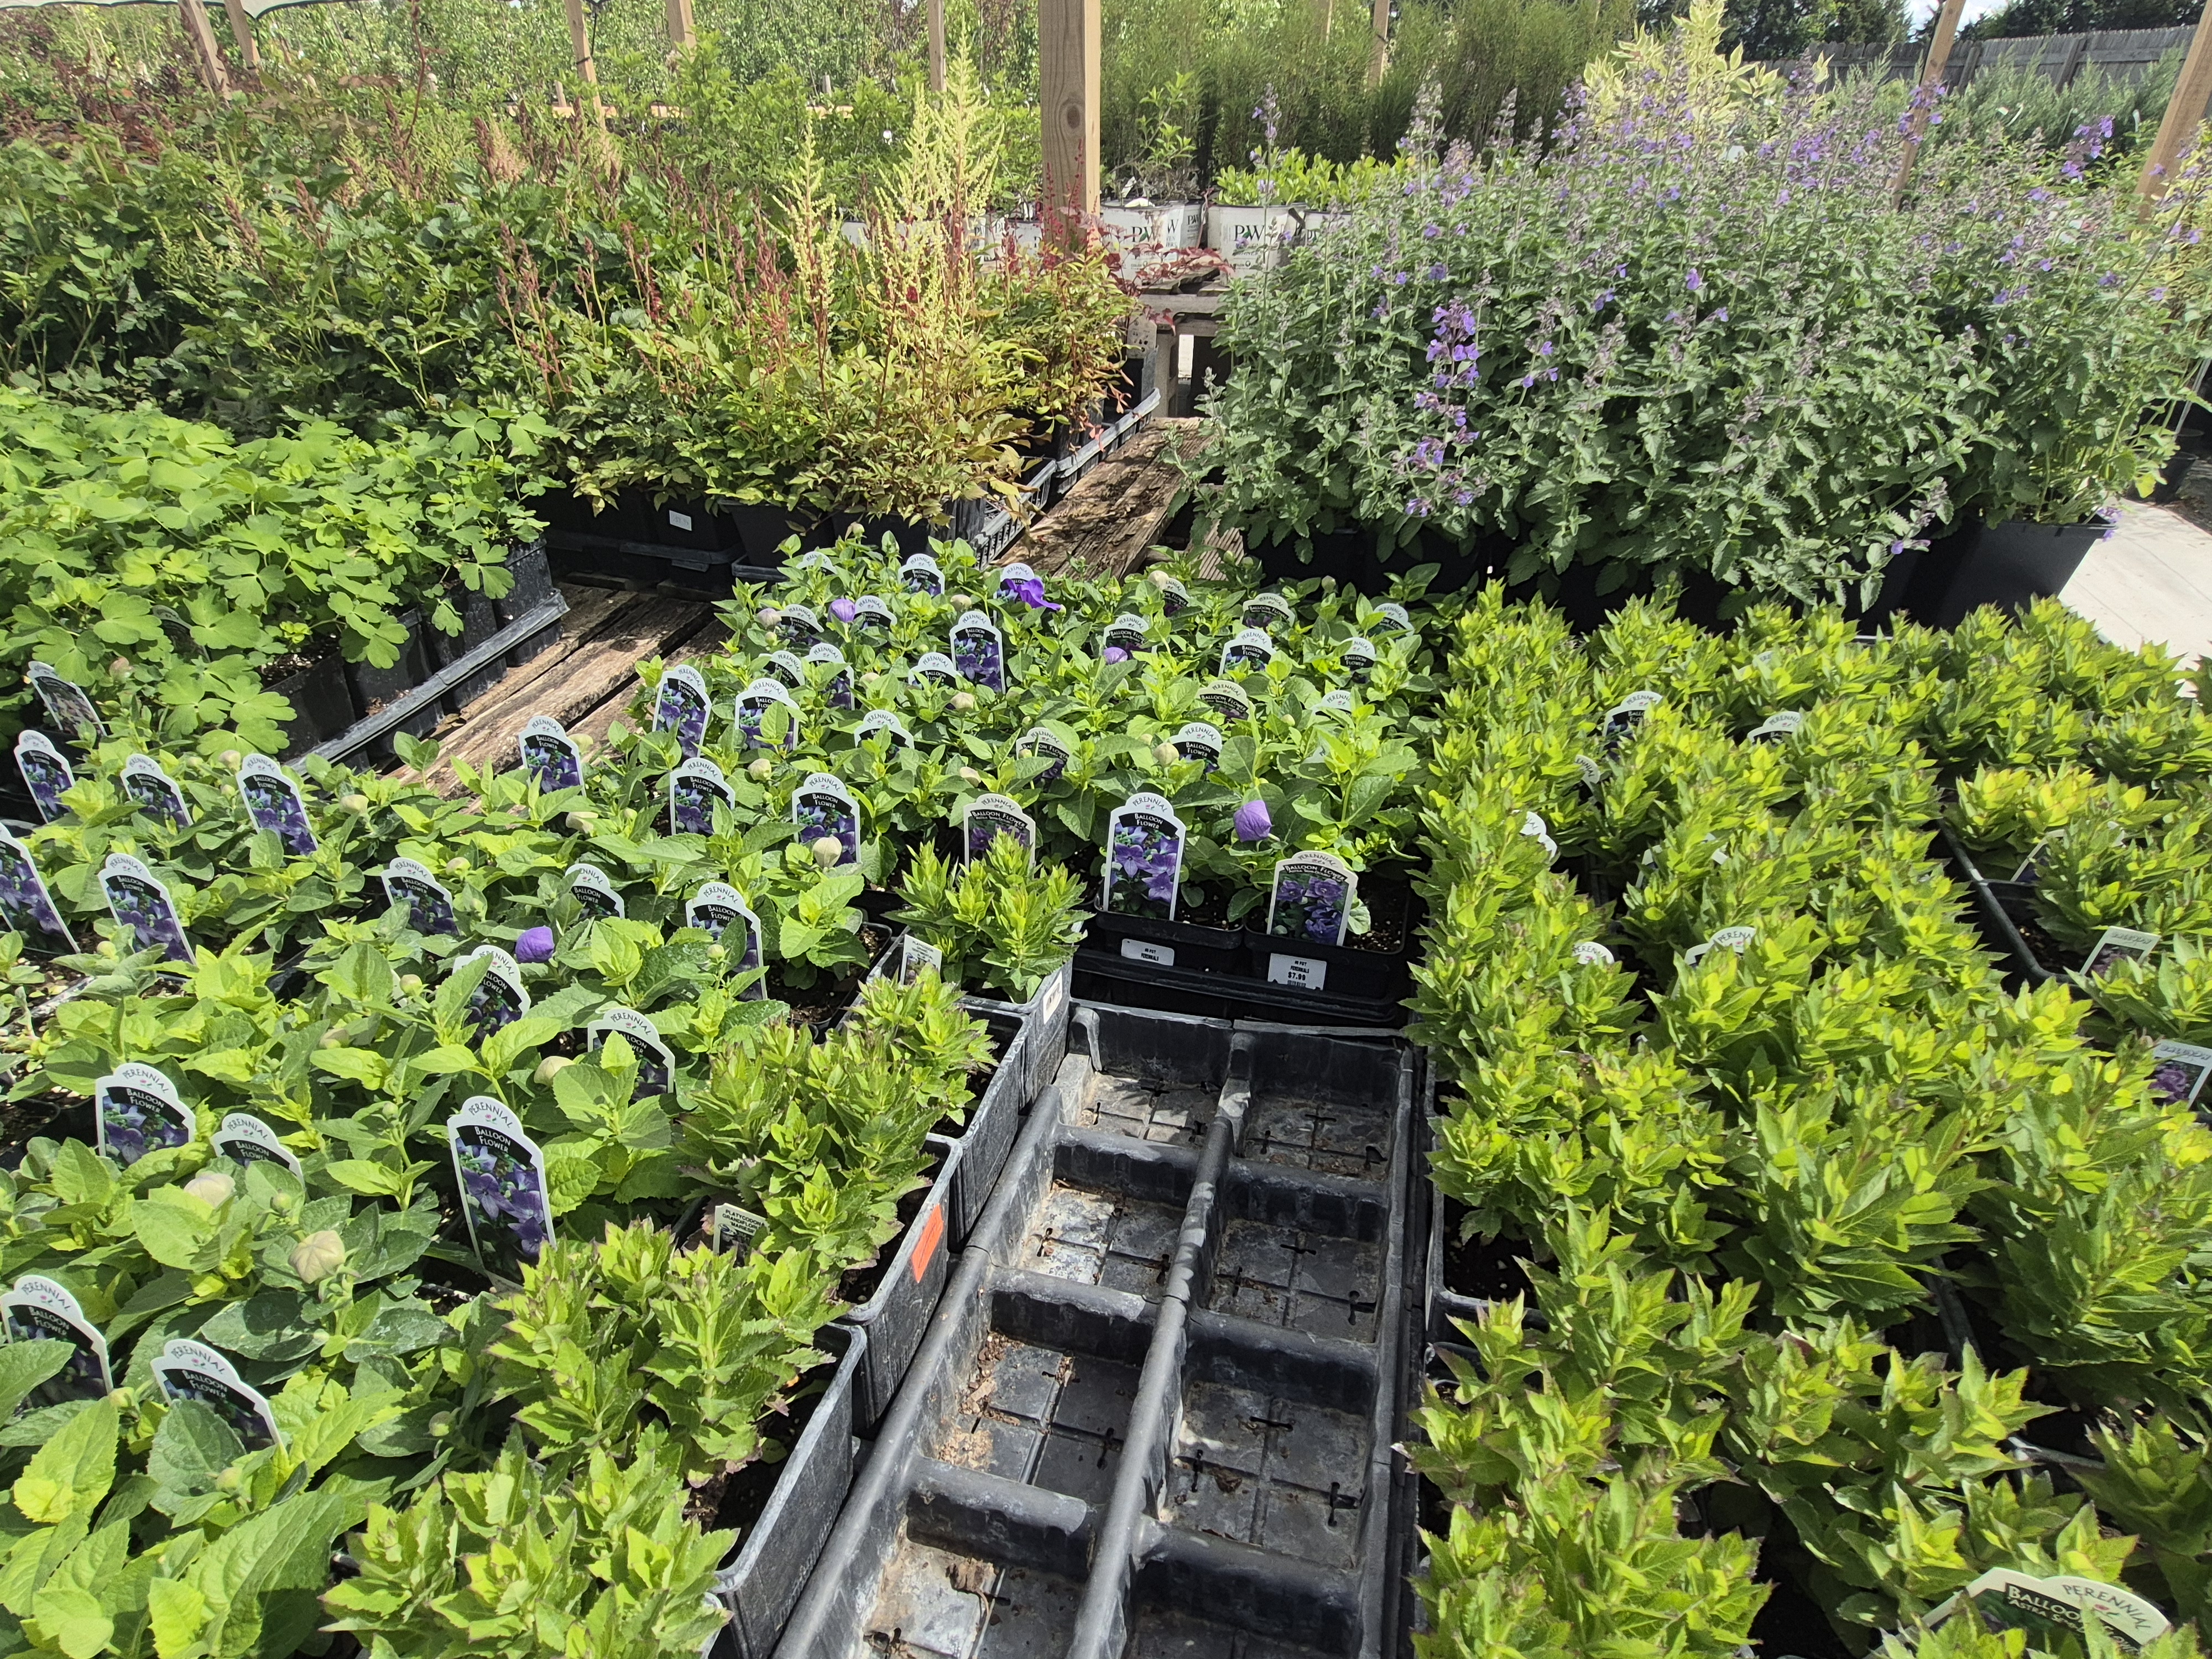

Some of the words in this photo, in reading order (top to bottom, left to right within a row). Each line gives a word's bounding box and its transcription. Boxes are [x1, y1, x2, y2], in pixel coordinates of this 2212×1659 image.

[1234, 225, 1265, 241] PW
[910, 556, 932, 567] PERENNIAL
[1006, 565, 1029, 576] PERENNIAL
[858, 598, 882, 609] PERENNIAL
[1259, 596, 1283, 607] PERENNIAL
[789, 608, 813, 620] PERENNIAL
[962, 614, 987, 624] PERENNIAL
[1119, 618, 1144, 629] PERENNIAL
[1241, 632, 1267, 645] PERENNIAL
[813, 646, 838, 659] PERENNIAL
[1242, 645, 1263, 655] BALLOON
[1243, 650, 1260, 658] FLOWER
[778, 654, 800, 672] PERENNIAL
[922, 656, 948, 667] PERENNIAL
[678, 669, 701, 687] PERENNIAL
[677, 680, 697, 697] BALLOON
[678, 686, 694, 699] FLOWER
[753, 682, 782, 695] PERENNIAL
[1212, 685, 1241, 697] PERENNIAL
[1228, 698, 1247, 712] FLOWER
[531, 719, 560, 733] PERENNIAL
[867, 713, 894, 726] PERENNIAL
[535, 735, 559, 745] BALLOON
[1185, 726, 1217, 742] PERENNIAL
[1186, 742, 1212, 752] BALLOON
[1188, 748, 1208, 757] FLOWER
[129, 758, 155, 771] PERENNIAL
[247, 757, 275, 772] PERENNIAL
[687, 761, 718, 778] PERENNIAL
[690, 777, 715, 789] BALLOON
[692, 782, 713, 793] FLOWER
[809, 776, 841, 792] PERENNIAL
[812, 794, 838, 804] BALLOON
[815, 799, 836, 808] FLOWER
[982, 797, 1015, 811] PERENNIAL
[1133, 797, 1167, 812] PERENNIAL
[1003, 813, 1027, 828] FLOWER
[1135, 813, 1163, 825] BALLOON
[1137, 820, 1160, 830] FLOWER
[110, 857, 142, 874] PERENNIAL
[1298, 853, 1336, 866] PERENNIAL
[395, 860, 428, 878] PERENNIAL
[1320, 867, 1345, 881] FLOWER
[117, 876, 144, 886] BALLOON
[400, 877, 428, 889] BALLOON
[573, 886, 601, 898] BALLOON
[577, 894, 599, 904] FLOWER
[703, 886, 739, 904] PERENNIAL
[708, 905, 736, 917] BALLOON
[483, 978, 503, 994] LOWER
[487, 972, 507, 990] LLOON
[611, 1013, 652, 1035] PERENNIAL
[623, 1035, 647, 1049] LLOON
[123, 1069, 169, 1093] PERENNIAL
[126, 1088, 164, 1108] BALLOON
[129, 1097, 161, 1114] FLOWER
[468, 1102, 513, 1128] PERENNIAL
[227, 1119, 268, 1140] PERENNIAL
[474, 1126, 511, 1146] BALLOON
[236, 1141, 270, 1156] BALLOON
[479, 1136, 509, 1153] FLOWER
[21, 1281, 71, 1312] PERENNIAL
[28, 1306, 69, 1330] BALLOON
[34, 1317, 67, 1335] FLOWER
[171, 1345, 226, 1374] PERENNIAL
[182, 1370, 227, 1392] BALLOON
[190, 1380, 226, 1400] FLOWER
[2008, 1585, 2080, 1620] BALLOO
[2062, 1584, 2151, 1630] PERENNIAL
